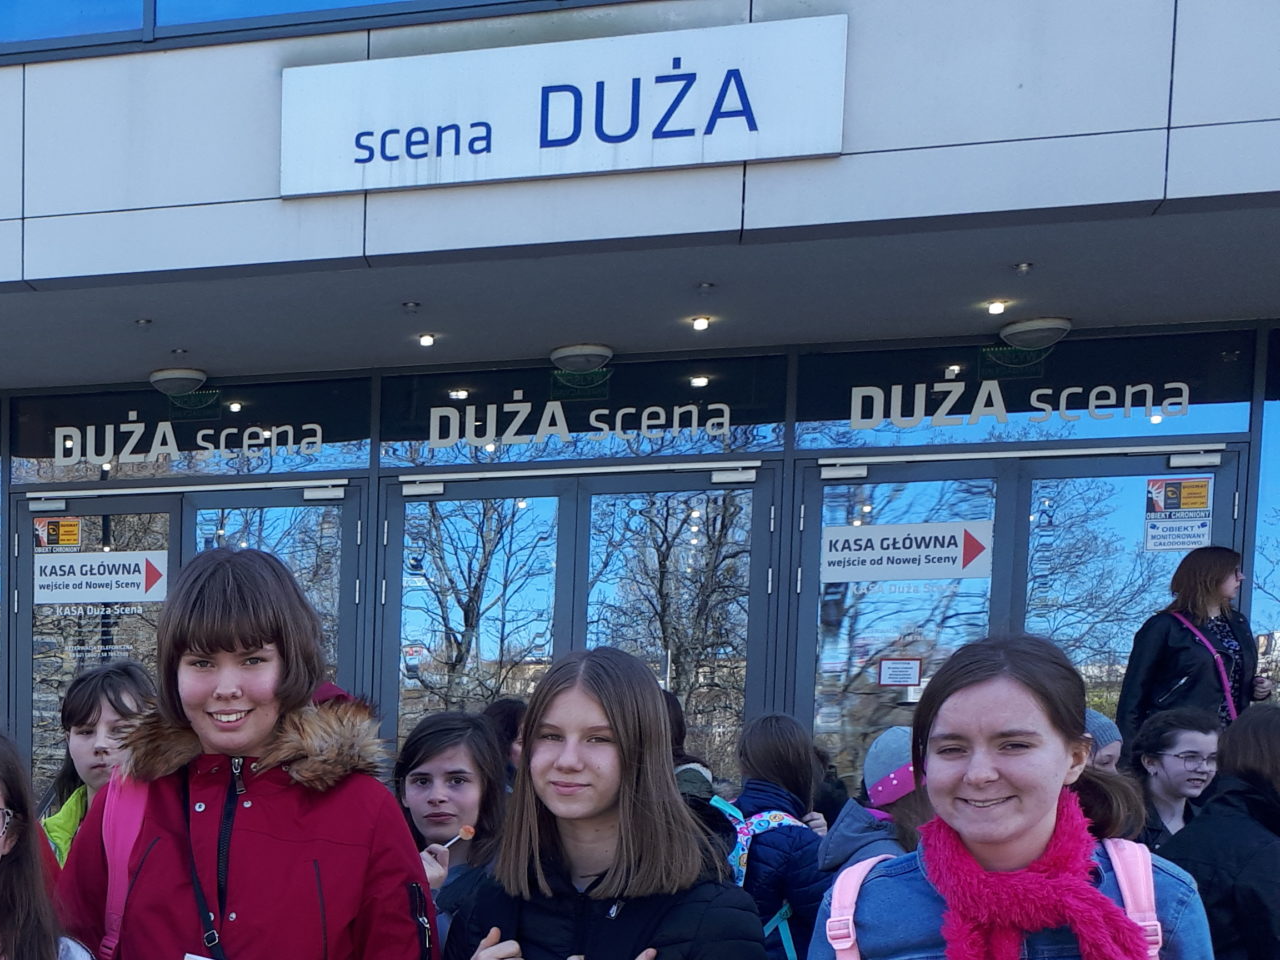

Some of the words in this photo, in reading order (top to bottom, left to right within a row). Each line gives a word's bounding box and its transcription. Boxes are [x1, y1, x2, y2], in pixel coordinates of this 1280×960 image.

[353, 120, 493, 164] scena
[538, 56, 759, 149] DUŻA
[850, 368, 1008, 430] DUŻA
[1028, 381, 1191, 423] scena
[428, 389, 571, 448] DUŻA
[587, 402, 731, 441] scena
[54, 410, 181, 467] DUŻA
[196, 423, 323, 459] scena
[1171, 511, 1210, 519] CHRONIONY
[1161, 525, 1195, 533] OBIEKT
[828, 539, 875, 553] KASA
[879, 533, 959, 551] GŁÓWNA
[1150, 533, 1205, 541] MONITOROWANY
[827, 556, 867, 568] wejście
[869, 556, 883, 566] od
[886, 555, 921, 566] Nowej
[924, 554, 958, 565] Sceny
[39, 564, 76, 577] KASA
[80, 561, 142, 576] GŁÓWNA
[38, 581, 70, 592] wejście
[72, 581, 83, 590] od
[85, 580, 113, 590] Nowej
[115, 579, 141, 590] Sceny
[56, 605, 84, 616] KASA
[86, 604, 112, 615] Duża
[114, 604, 143, 615] Scena
